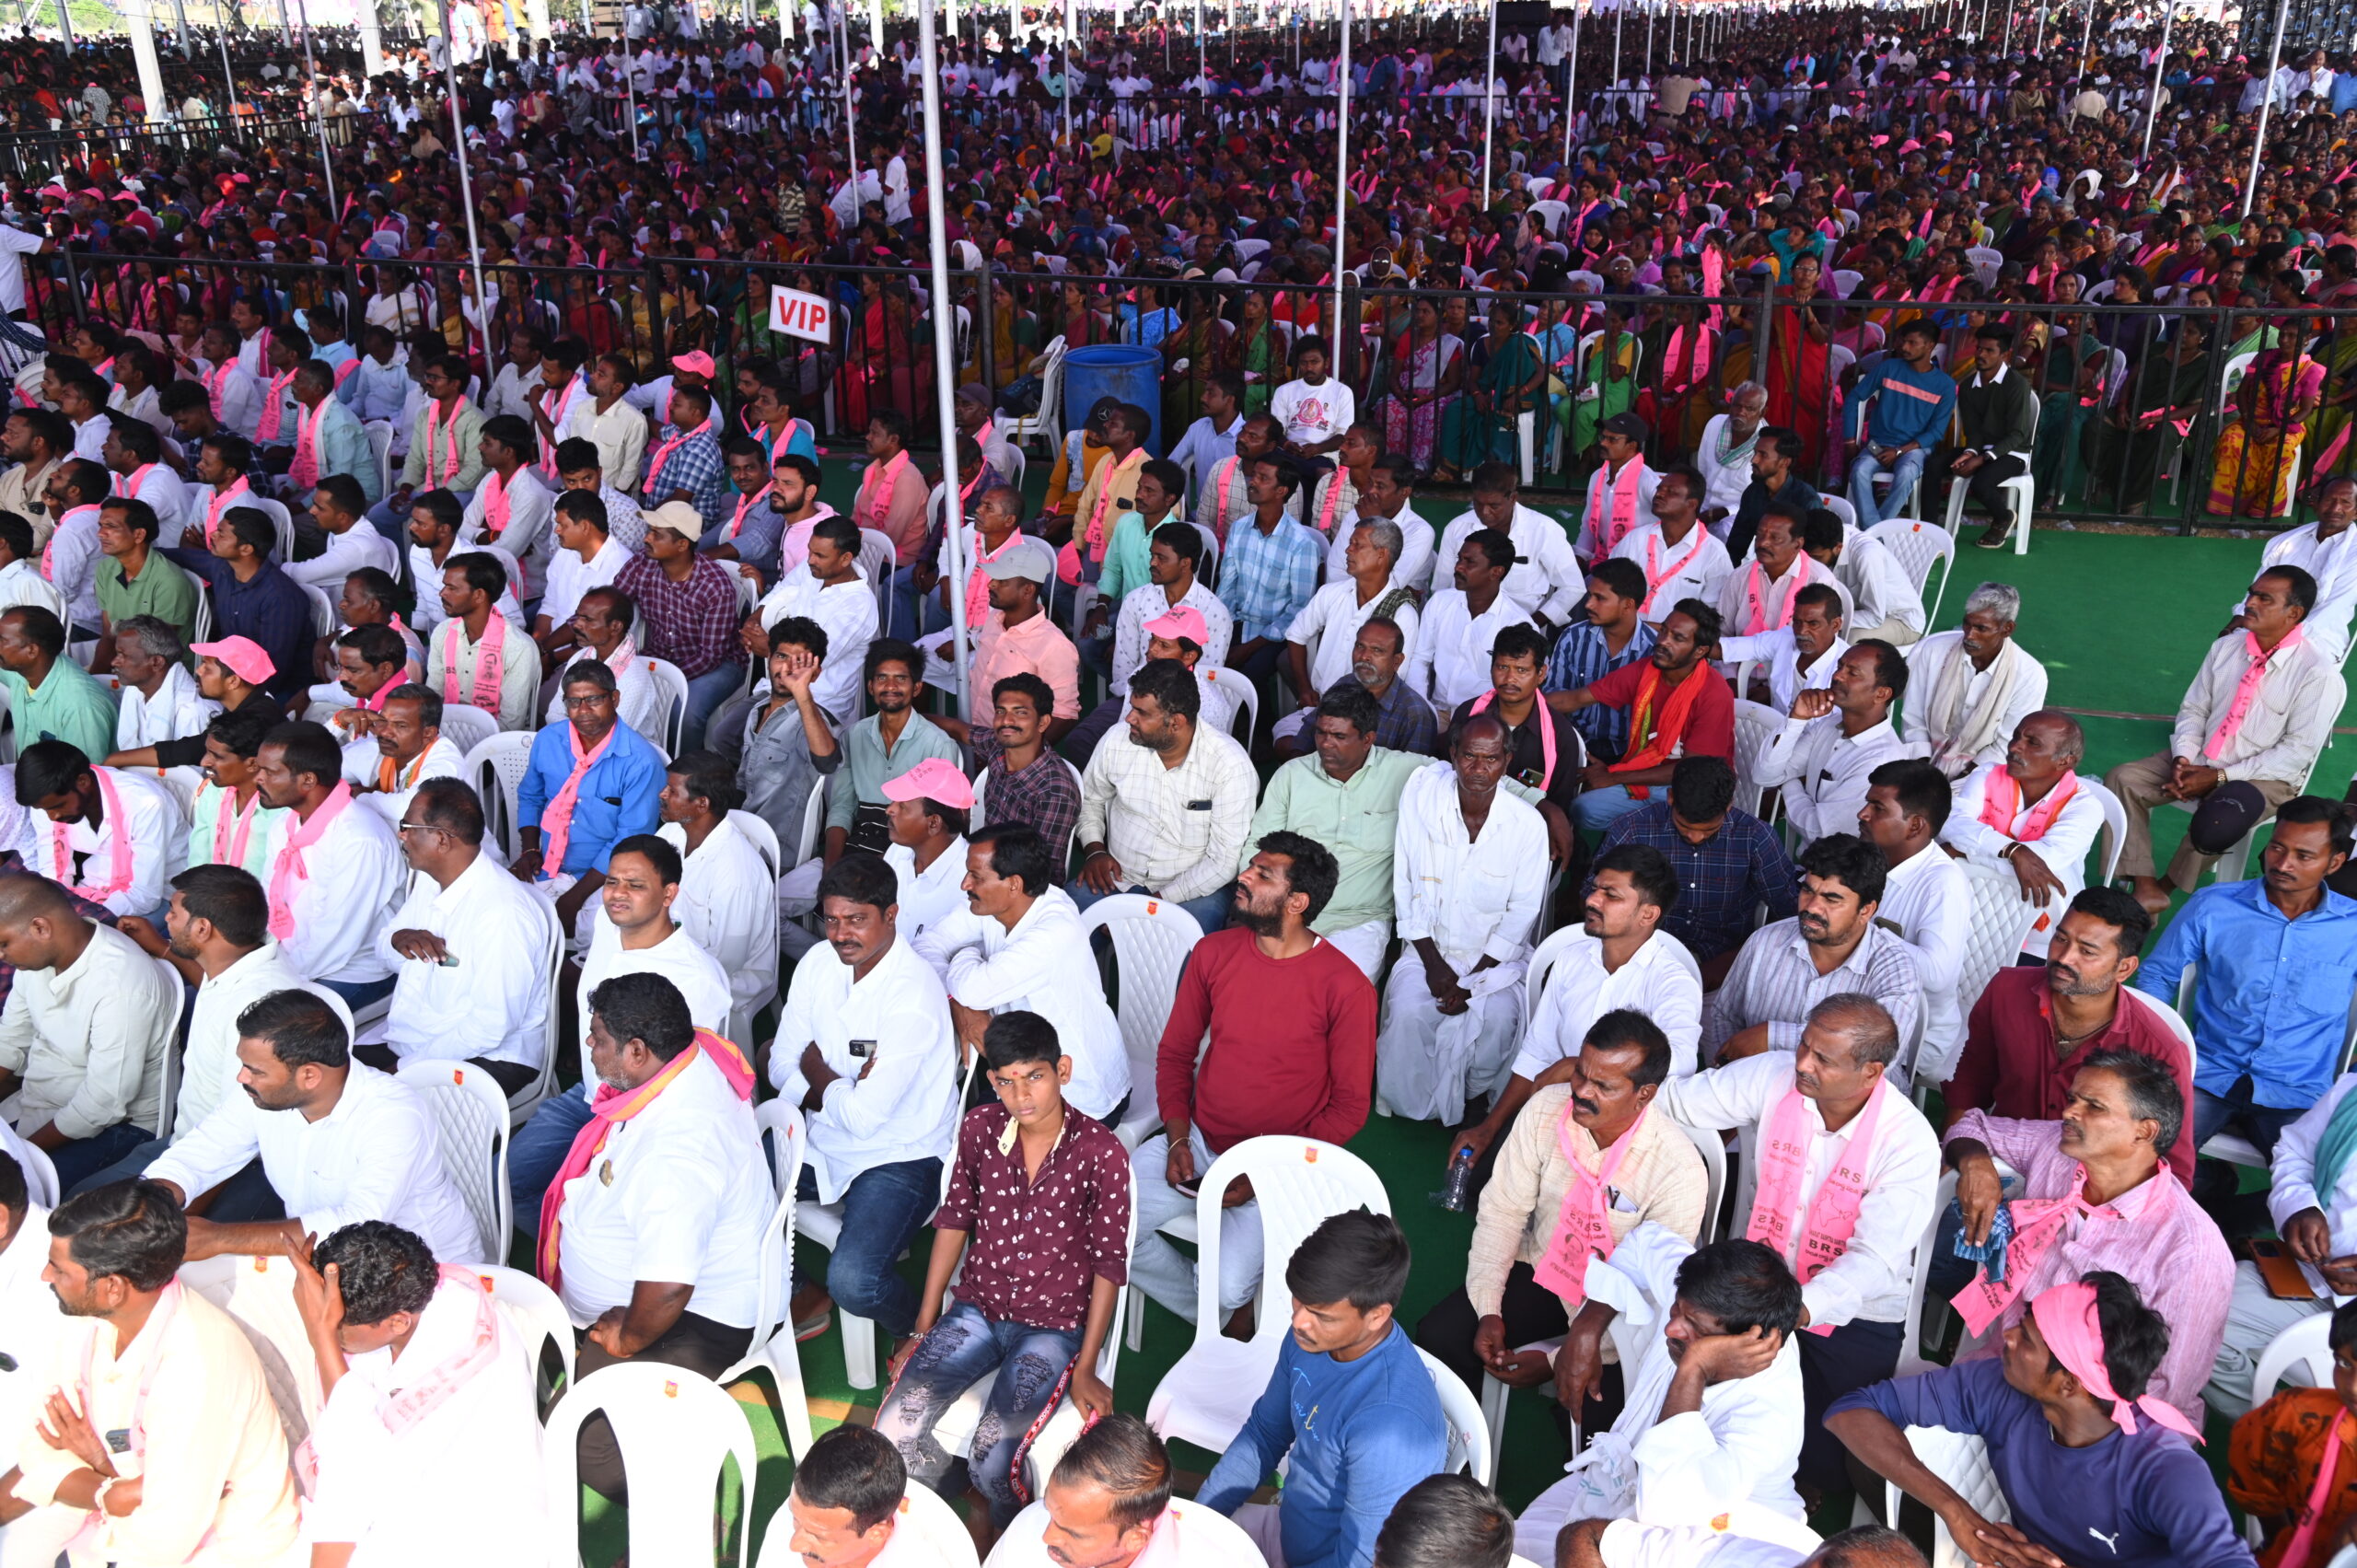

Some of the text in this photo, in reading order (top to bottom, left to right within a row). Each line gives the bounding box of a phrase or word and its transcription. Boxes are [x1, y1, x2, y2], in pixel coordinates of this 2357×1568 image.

[778, 296, 826, 331] VIP
[1834, 1165, 1862, 1183] RS
[1808, 1238, 1843, 1256] BRS
